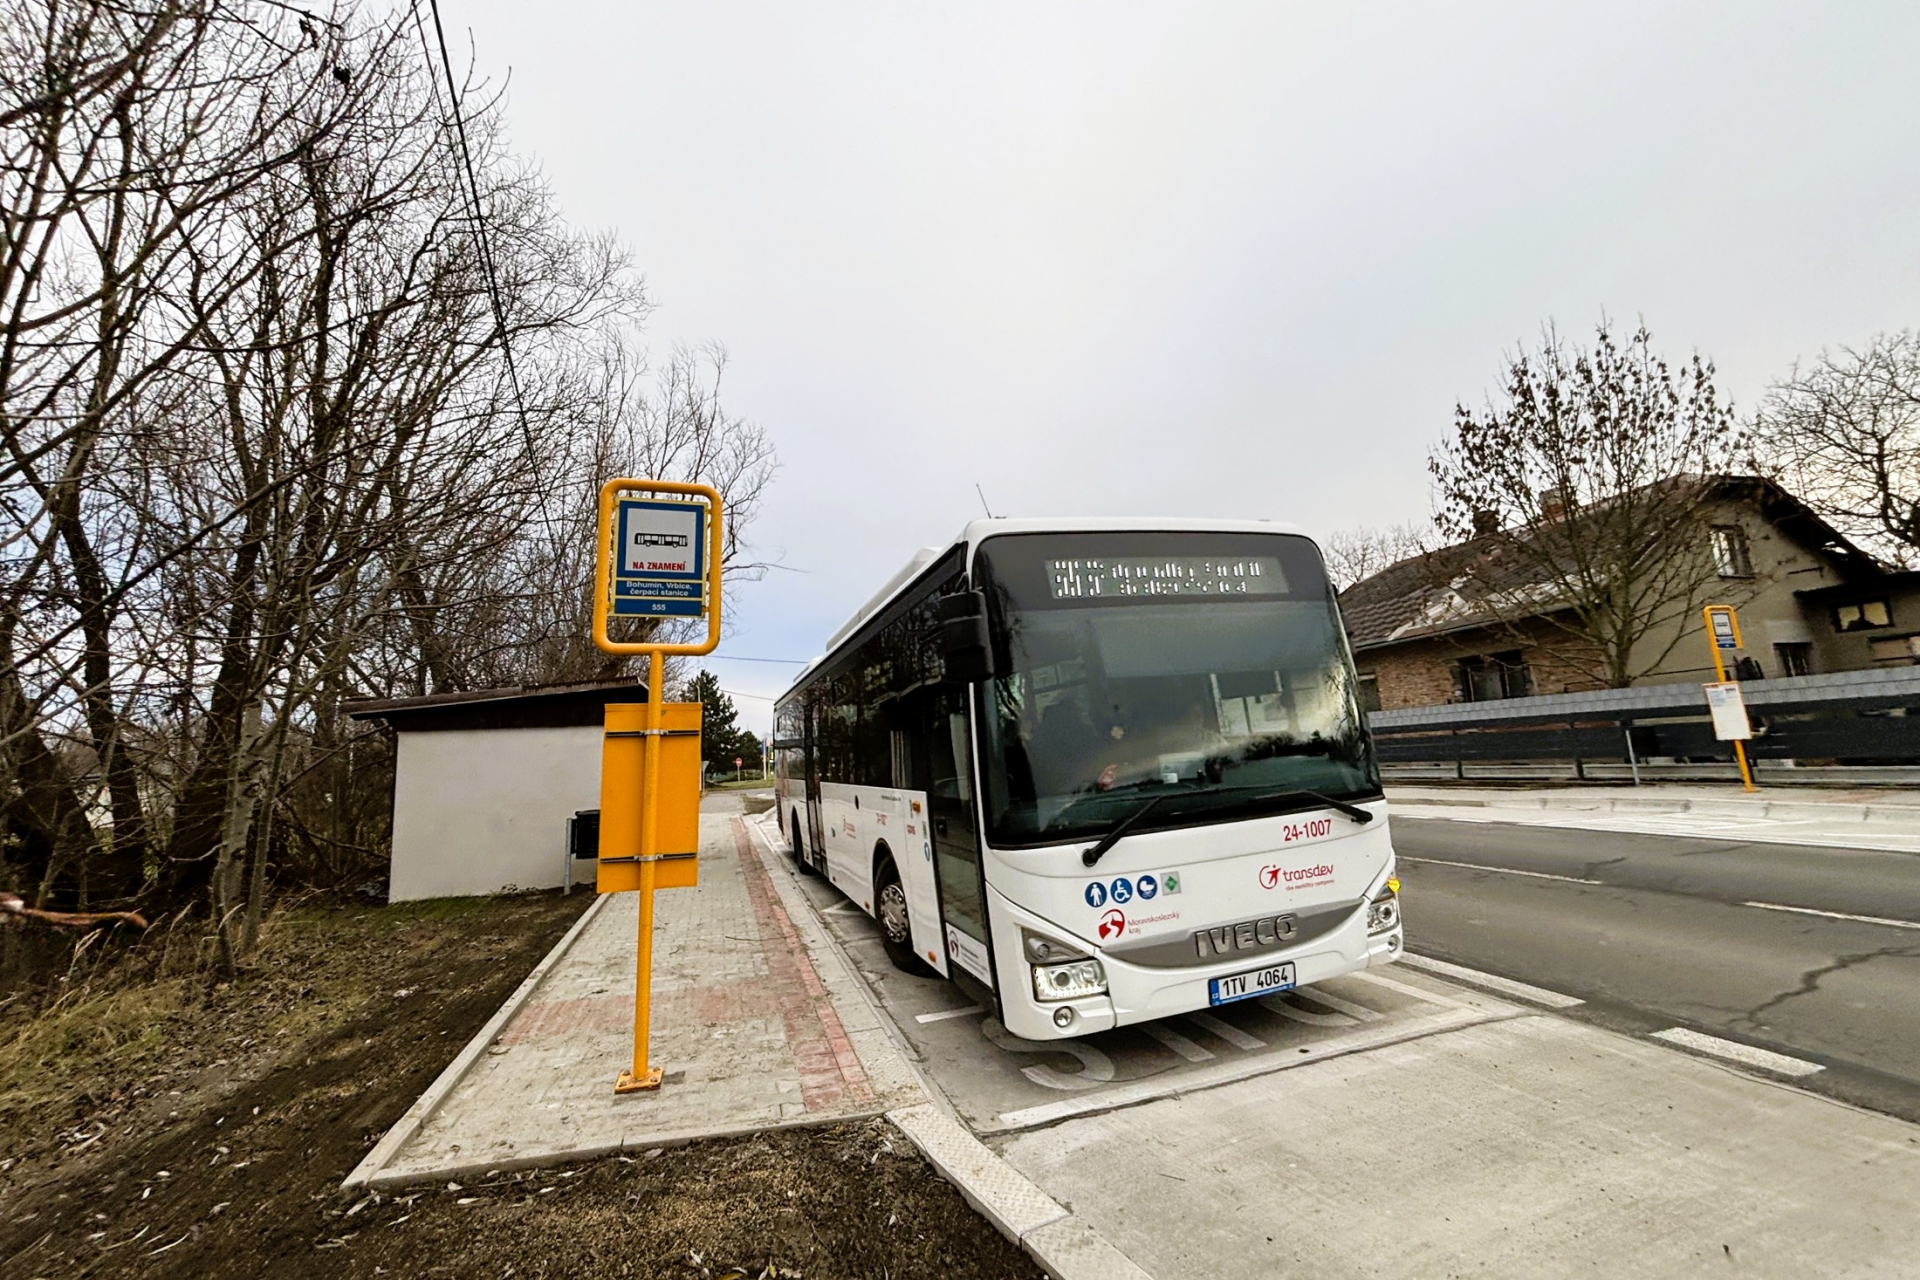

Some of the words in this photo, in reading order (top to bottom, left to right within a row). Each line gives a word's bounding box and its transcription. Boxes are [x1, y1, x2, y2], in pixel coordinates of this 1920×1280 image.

[633, 561, 645, 570] NA
[647, 561, 686, 571] ZNAMENÍ
[666, 582, 693, 591] Vrbice,
[660, 589, 689, 597] stanice
[652, 603, 667, 611] 555
[1283, 819, 1332, 842] 24-1007
[1283, 864, 1334, 882] transdev
[1127, 911, 1180, 926] Moravskoslezský
[1128, 927, 1141, 935] kraj
[1194, 914, 1298, 958] IVECO
[1222, 976, 1246, 996] 1TV
[1257, 967, 1288, 988] 4064
